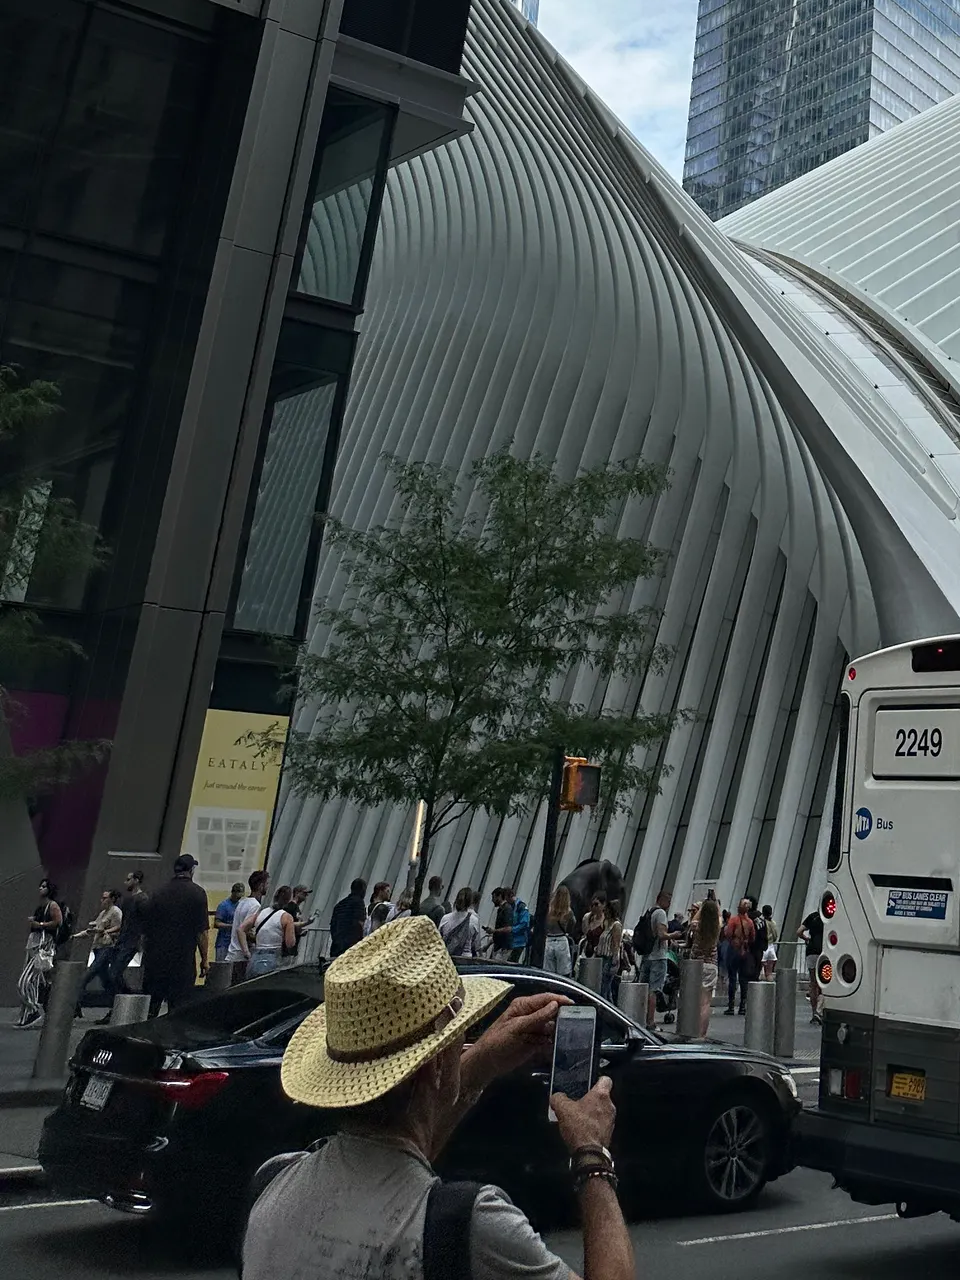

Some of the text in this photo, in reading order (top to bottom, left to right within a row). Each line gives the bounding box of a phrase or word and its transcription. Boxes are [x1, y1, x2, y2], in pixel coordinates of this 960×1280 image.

[894, 727, 943, 758] 2249
[208, 757, 269, 771] EATALY
[876, 817, 894, 830] Bus
[902, 892, 912, 900] BUS
[913, 892, 929, 900] LANES
[929, 893, 946, 902] CLEAR
